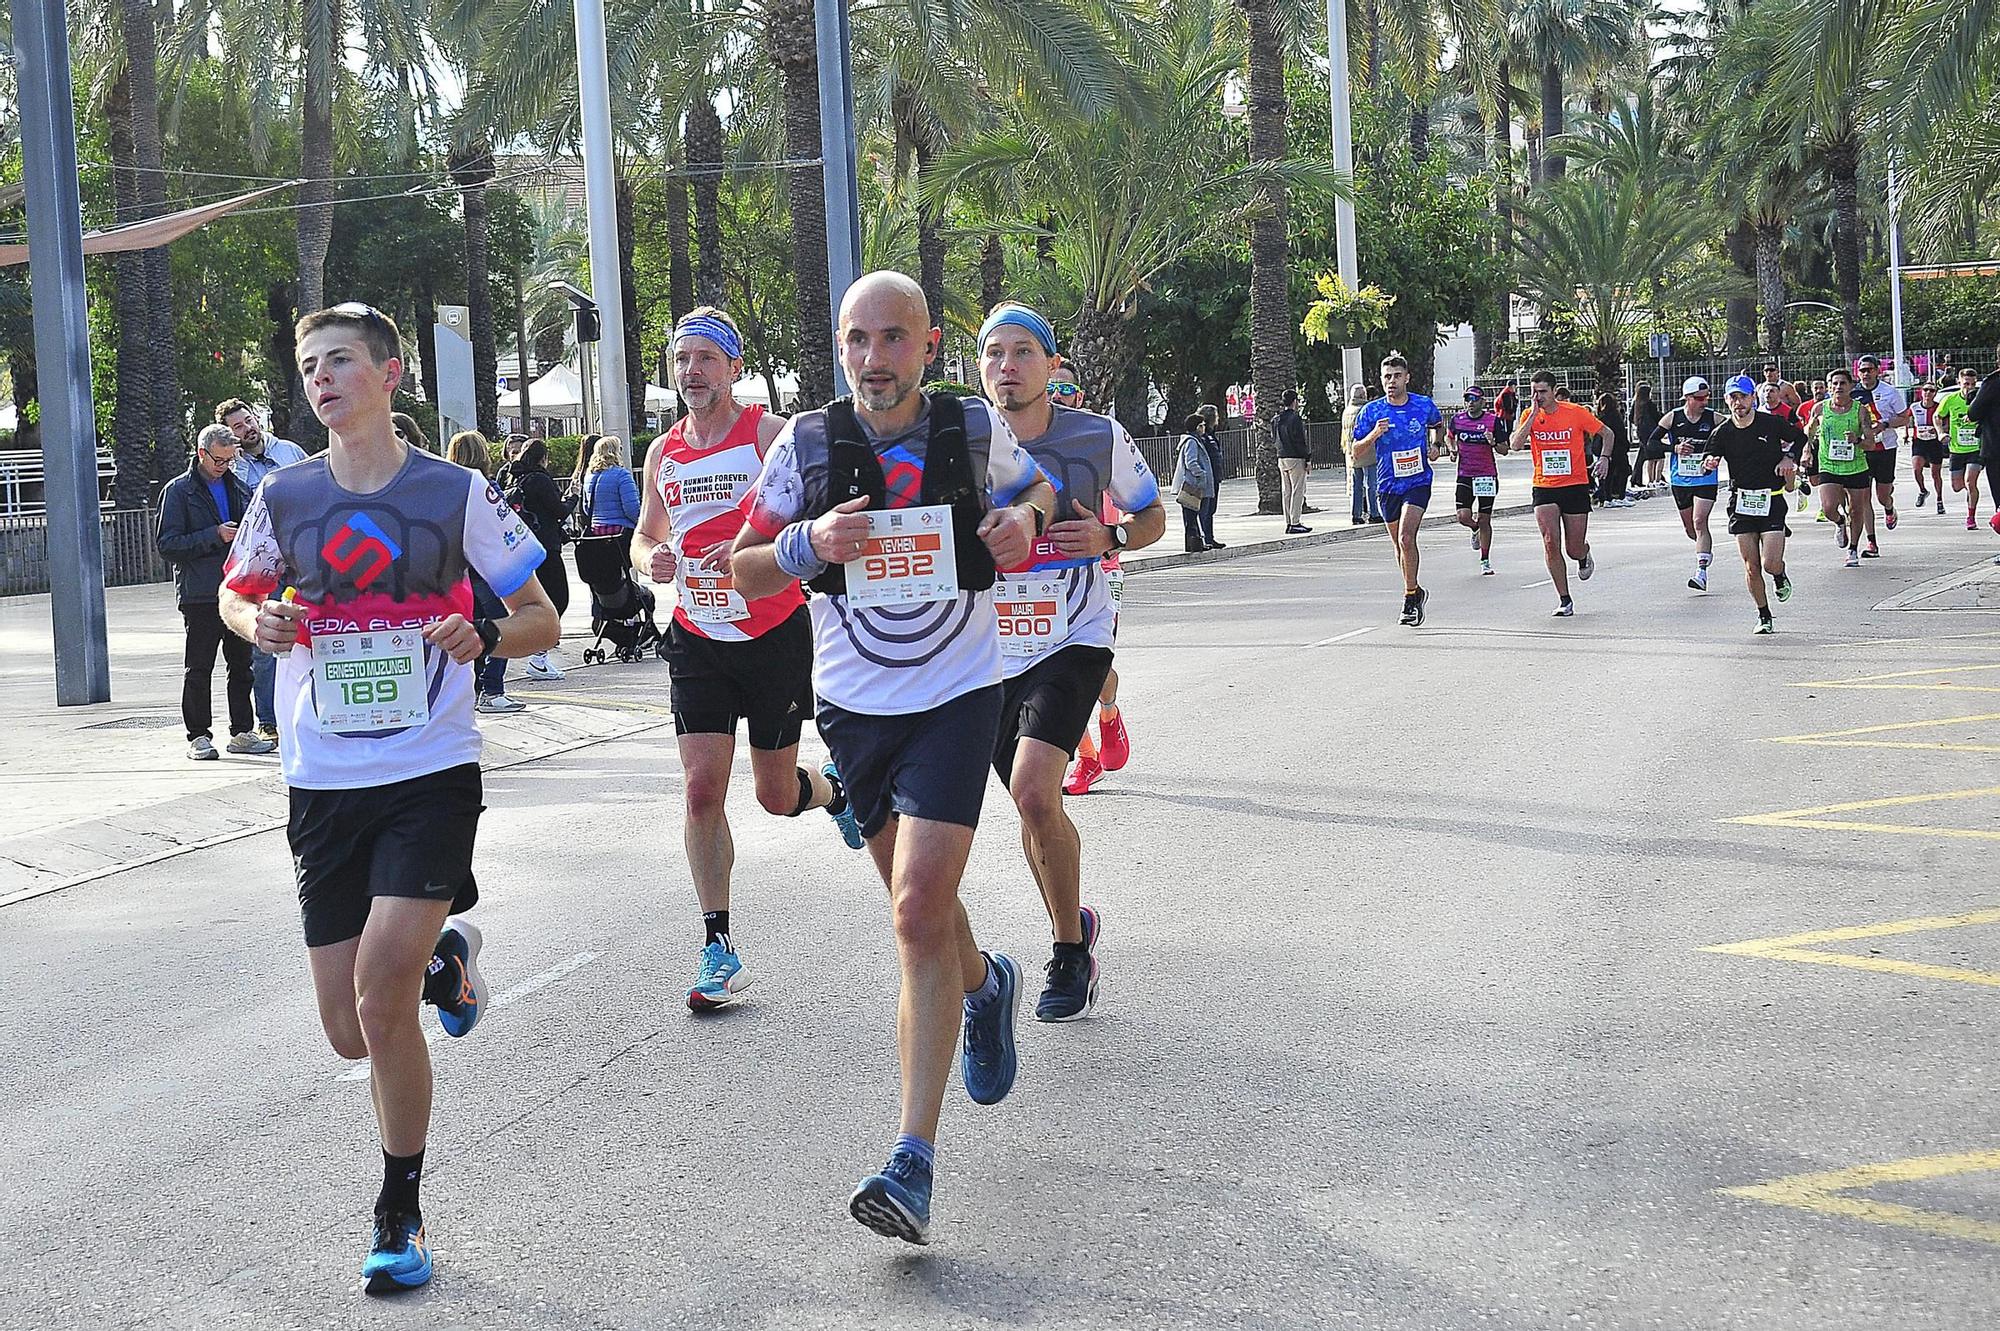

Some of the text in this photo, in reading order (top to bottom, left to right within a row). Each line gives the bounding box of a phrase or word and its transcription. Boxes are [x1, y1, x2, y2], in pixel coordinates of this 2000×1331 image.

[1533, 428, 1572, 440] saxun
[683, 476, 713, 487] RUNNING
[714, 474, 748, 483] FOREVER
[683, 483, 734, 495] RUNNING CLUB
[684, 492, 732, 504] TAUNTON
[1742, 500, 1765, 509] 256
[879, 537, 917, 554] YEVHEN
[865, 555, 934, 580] 932
[690, 591, 729, 607] 1219
[1011, 604, 1035, 615] MAURI
[998, 618, 1051, 636] 900
[327, 657, 410, 680] ERNESTO MUZUNGU
[341, 679, 398, 705] 189
